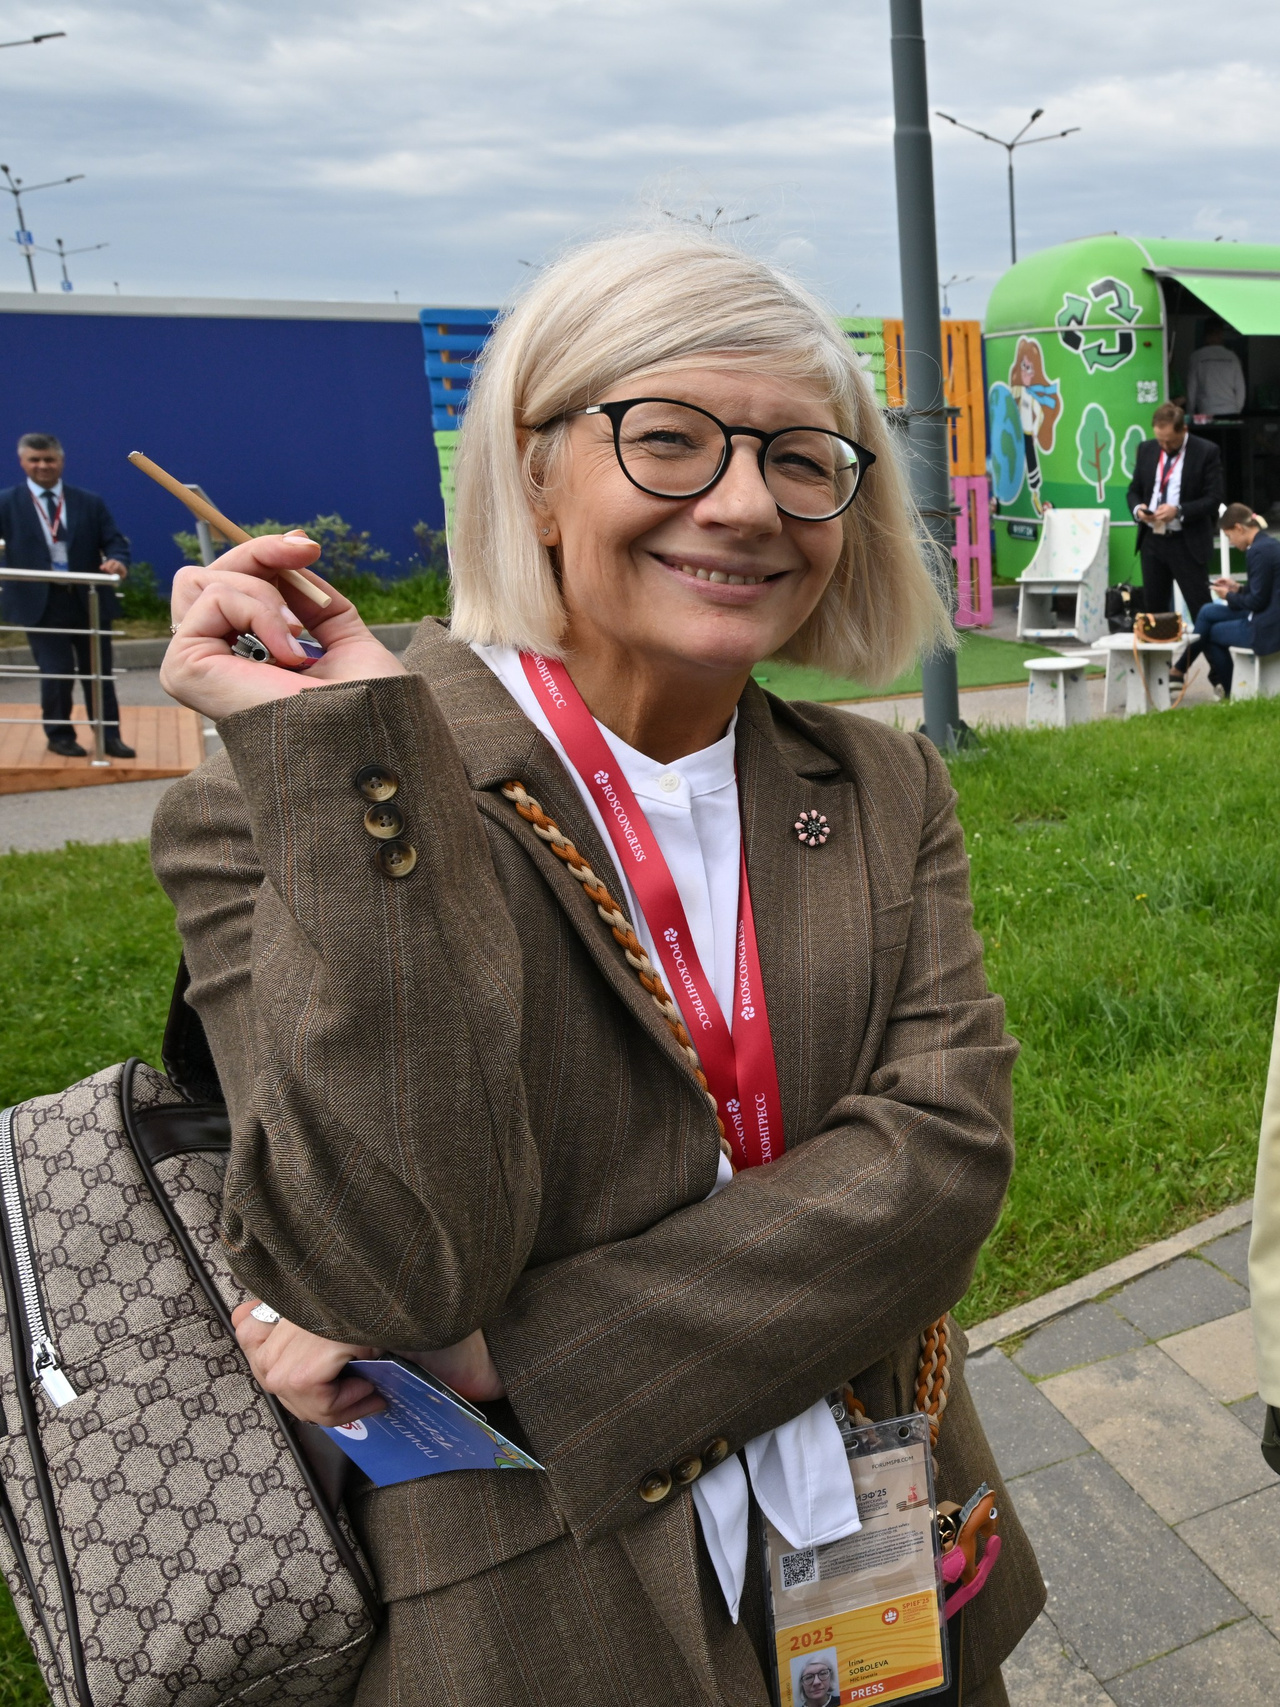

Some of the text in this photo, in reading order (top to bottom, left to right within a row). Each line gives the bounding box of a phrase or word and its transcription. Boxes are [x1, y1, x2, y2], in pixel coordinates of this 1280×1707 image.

[602, 783, 646, 863] ROSCONGRESS
[670, 942, 713, 1031] РОСКОНГРЕСС
[383, 1410, 440, 1459] ПРИГЛА
[872, 1456, 914, 1470] FORUMSPB.COM
[902, 1597, 930, 1610] SPIEF'25
[790, 1626, 834, 1651] 2025
[848, 1658, 864, 1667] Irina
[849, 1659, 889, 1676] SOBOLEVA
[850, 1682, 885, 1700] PRESS
